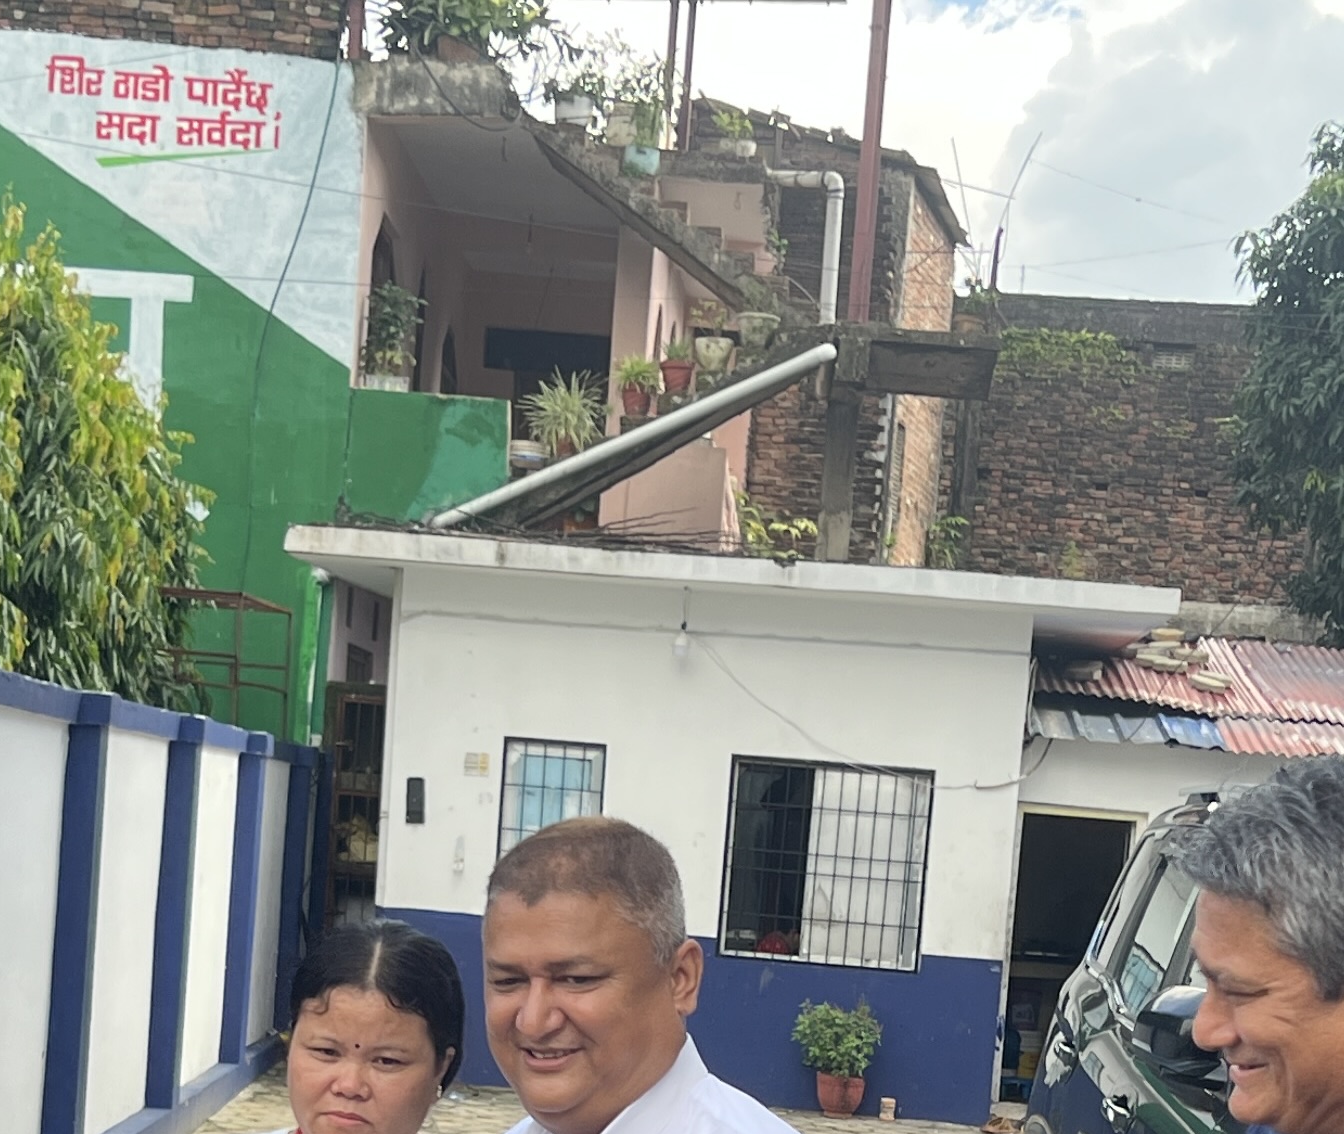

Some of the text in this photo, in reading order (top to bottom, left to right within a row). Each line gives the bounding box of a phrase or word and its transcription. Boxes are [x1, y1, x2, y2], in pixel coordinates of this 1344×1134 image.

[46, 55, 106, 96] शिर
[112, 64, 175, 103] ठाडो
[95, 111, 162, 146] सदा
